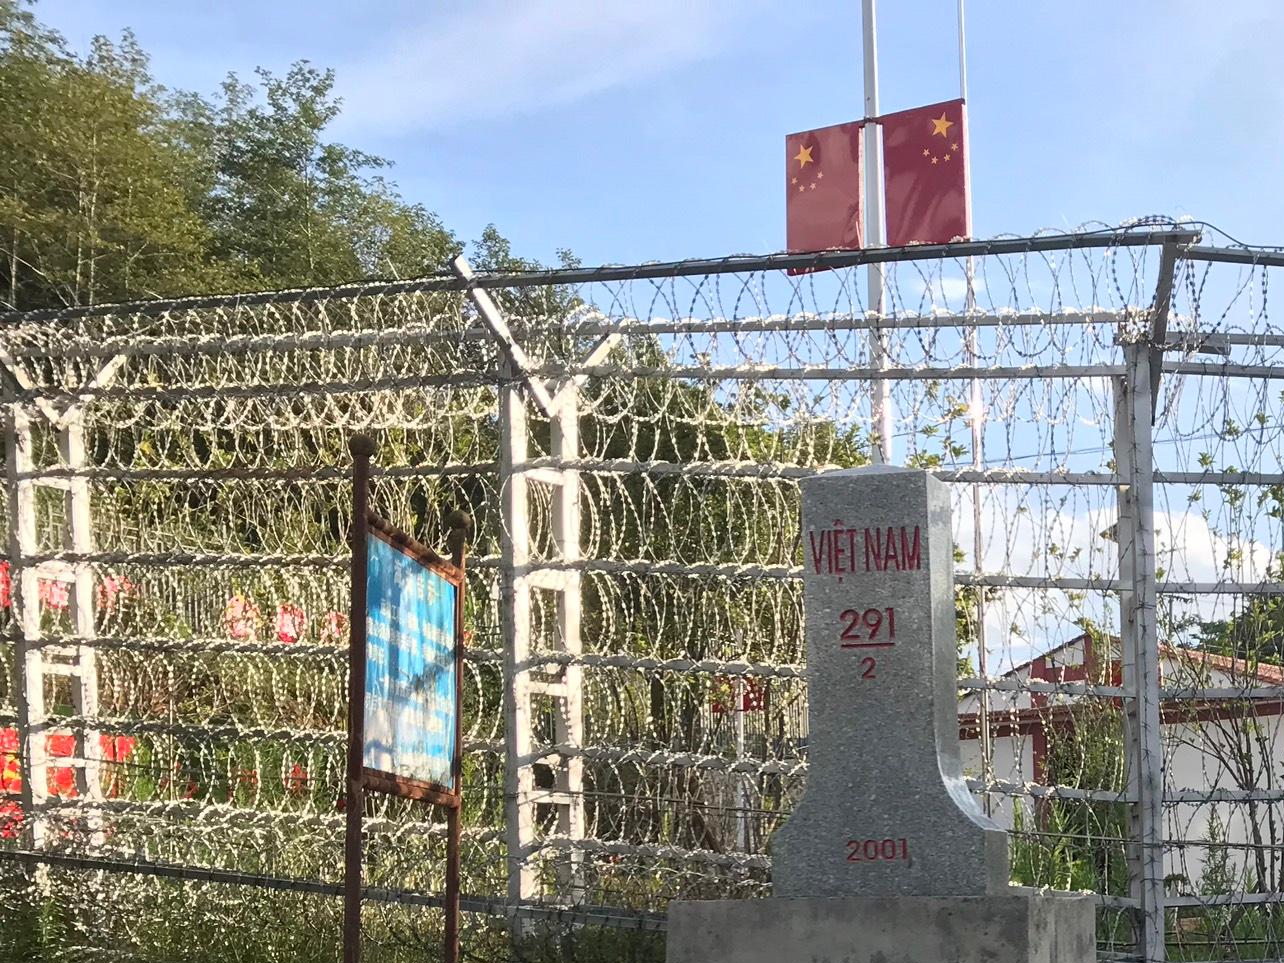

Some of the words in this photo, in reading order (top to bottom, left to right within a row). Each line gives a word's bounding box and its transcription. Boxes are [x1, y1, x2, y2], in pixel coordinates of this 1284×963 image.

[809, 519, 858, 583] VIỆT
[864, 526, 922, 571] NAM
[840, 607, 896, 642] 291
[861, 656, 877, 680] 2
[847, 838, 909, 862] 2001
